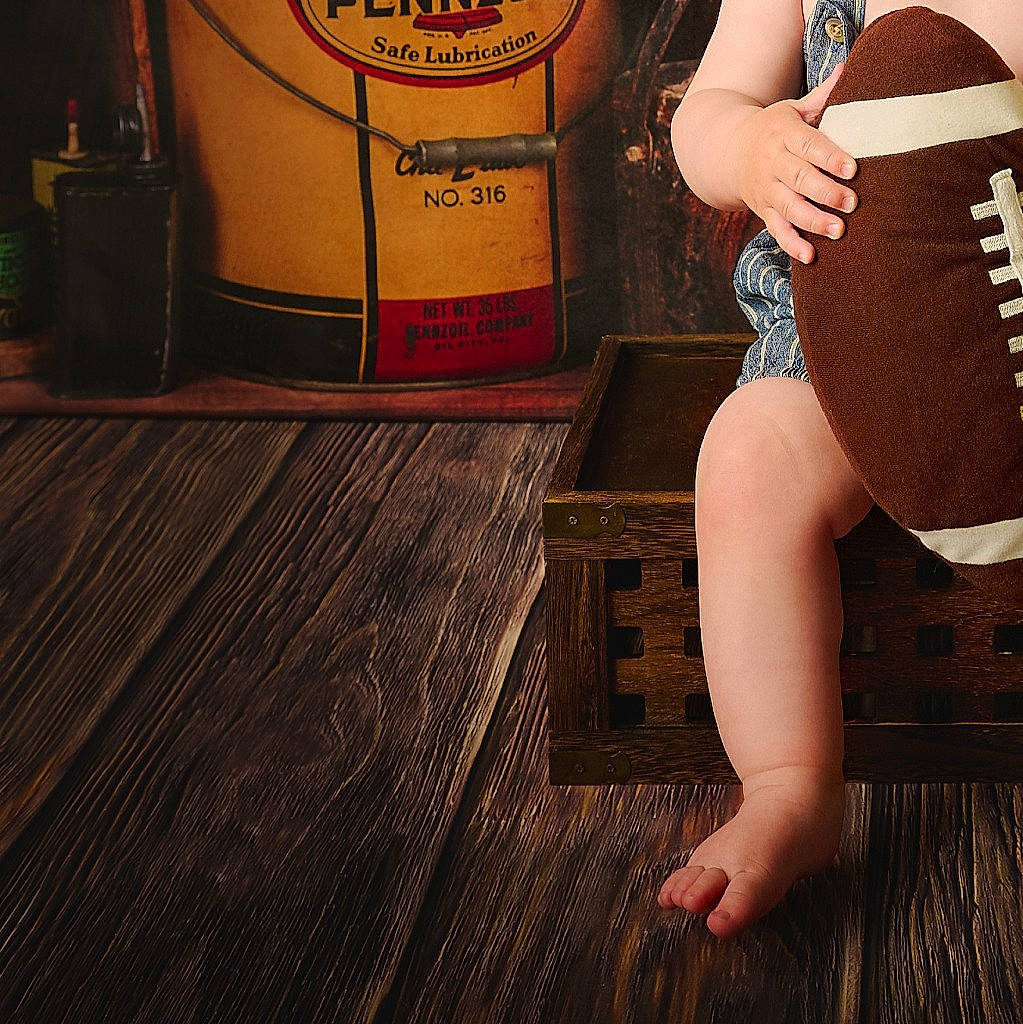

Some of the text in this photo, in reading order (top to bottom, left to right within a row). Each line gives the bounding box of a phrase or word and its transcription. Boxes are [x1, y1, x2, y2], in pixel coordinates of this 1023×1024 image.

[371, 30, 538, 64] Safe Lubrication
[424, 184, 507, 208] NO. 316
